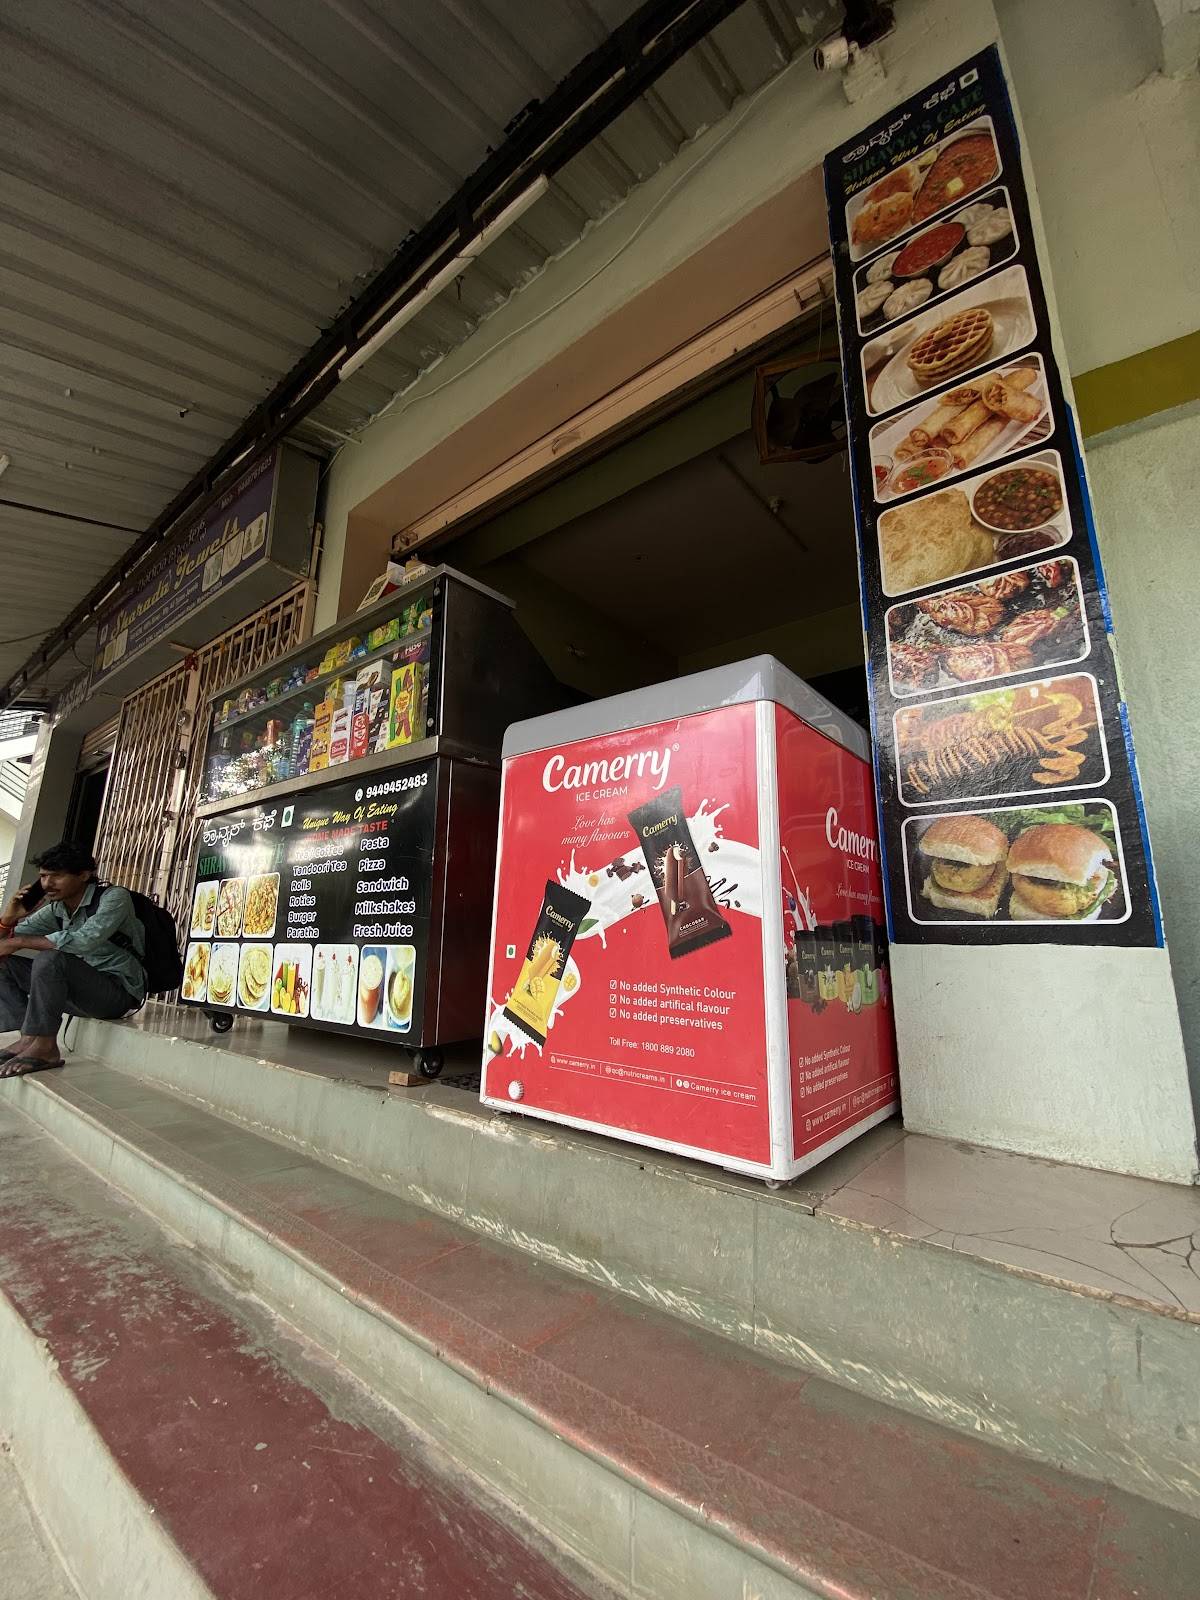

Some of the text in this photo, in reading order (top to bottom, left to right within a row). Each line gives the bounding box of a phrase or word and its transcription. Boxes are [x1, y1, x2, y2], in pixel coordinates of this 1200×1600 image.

[844, 104, 987, 195] Unique Way Of Eating
[366, 773, 428, 798] 9449452483
[576, 786, 629, 803] ICE CREAM
[303, 802, 400, 831] Unique Way Of Eating
[571, 807, 616, 831] Love has
[358, 820, 389, 833] TASTE
[643, 814, 678, 838] Camerry
[360, 837, 390, 851] Pasta
[561, 828, 631, 848] many flavours
[293, 860, 347, 876] Tandoori Tea
[358, 858, 386, 872] Pizza
[290, 879, 312, 892] Rolls
[356, 876, 409, 893] Sandwich
[289, 894, 316, 907] Roties
[354, 899, 416, 915] Milkshakes
[288, 911, 317, 924] Burger
[545, 905, 575, 932] Camerry
[286, 926, 320, 938] Paratha
[353, 922, 413, 937] Fresh Juice
[619, 981, 736, 1000] No added Synthetic Colour
[619, 995, 731, 1015] No added artifical flavour
[619, 1009, 723, 1030] No added preservatives
[609, 1037, 620, 1046] Toll
[641, 1042, 659, 1052] 1800
[660, 1044, 674, 1054] 889
[676, 1047, 695, 1058] 2080
[690, 1082, 720, 1095] Camerry
[733, 1090, 756, 1101] cream
